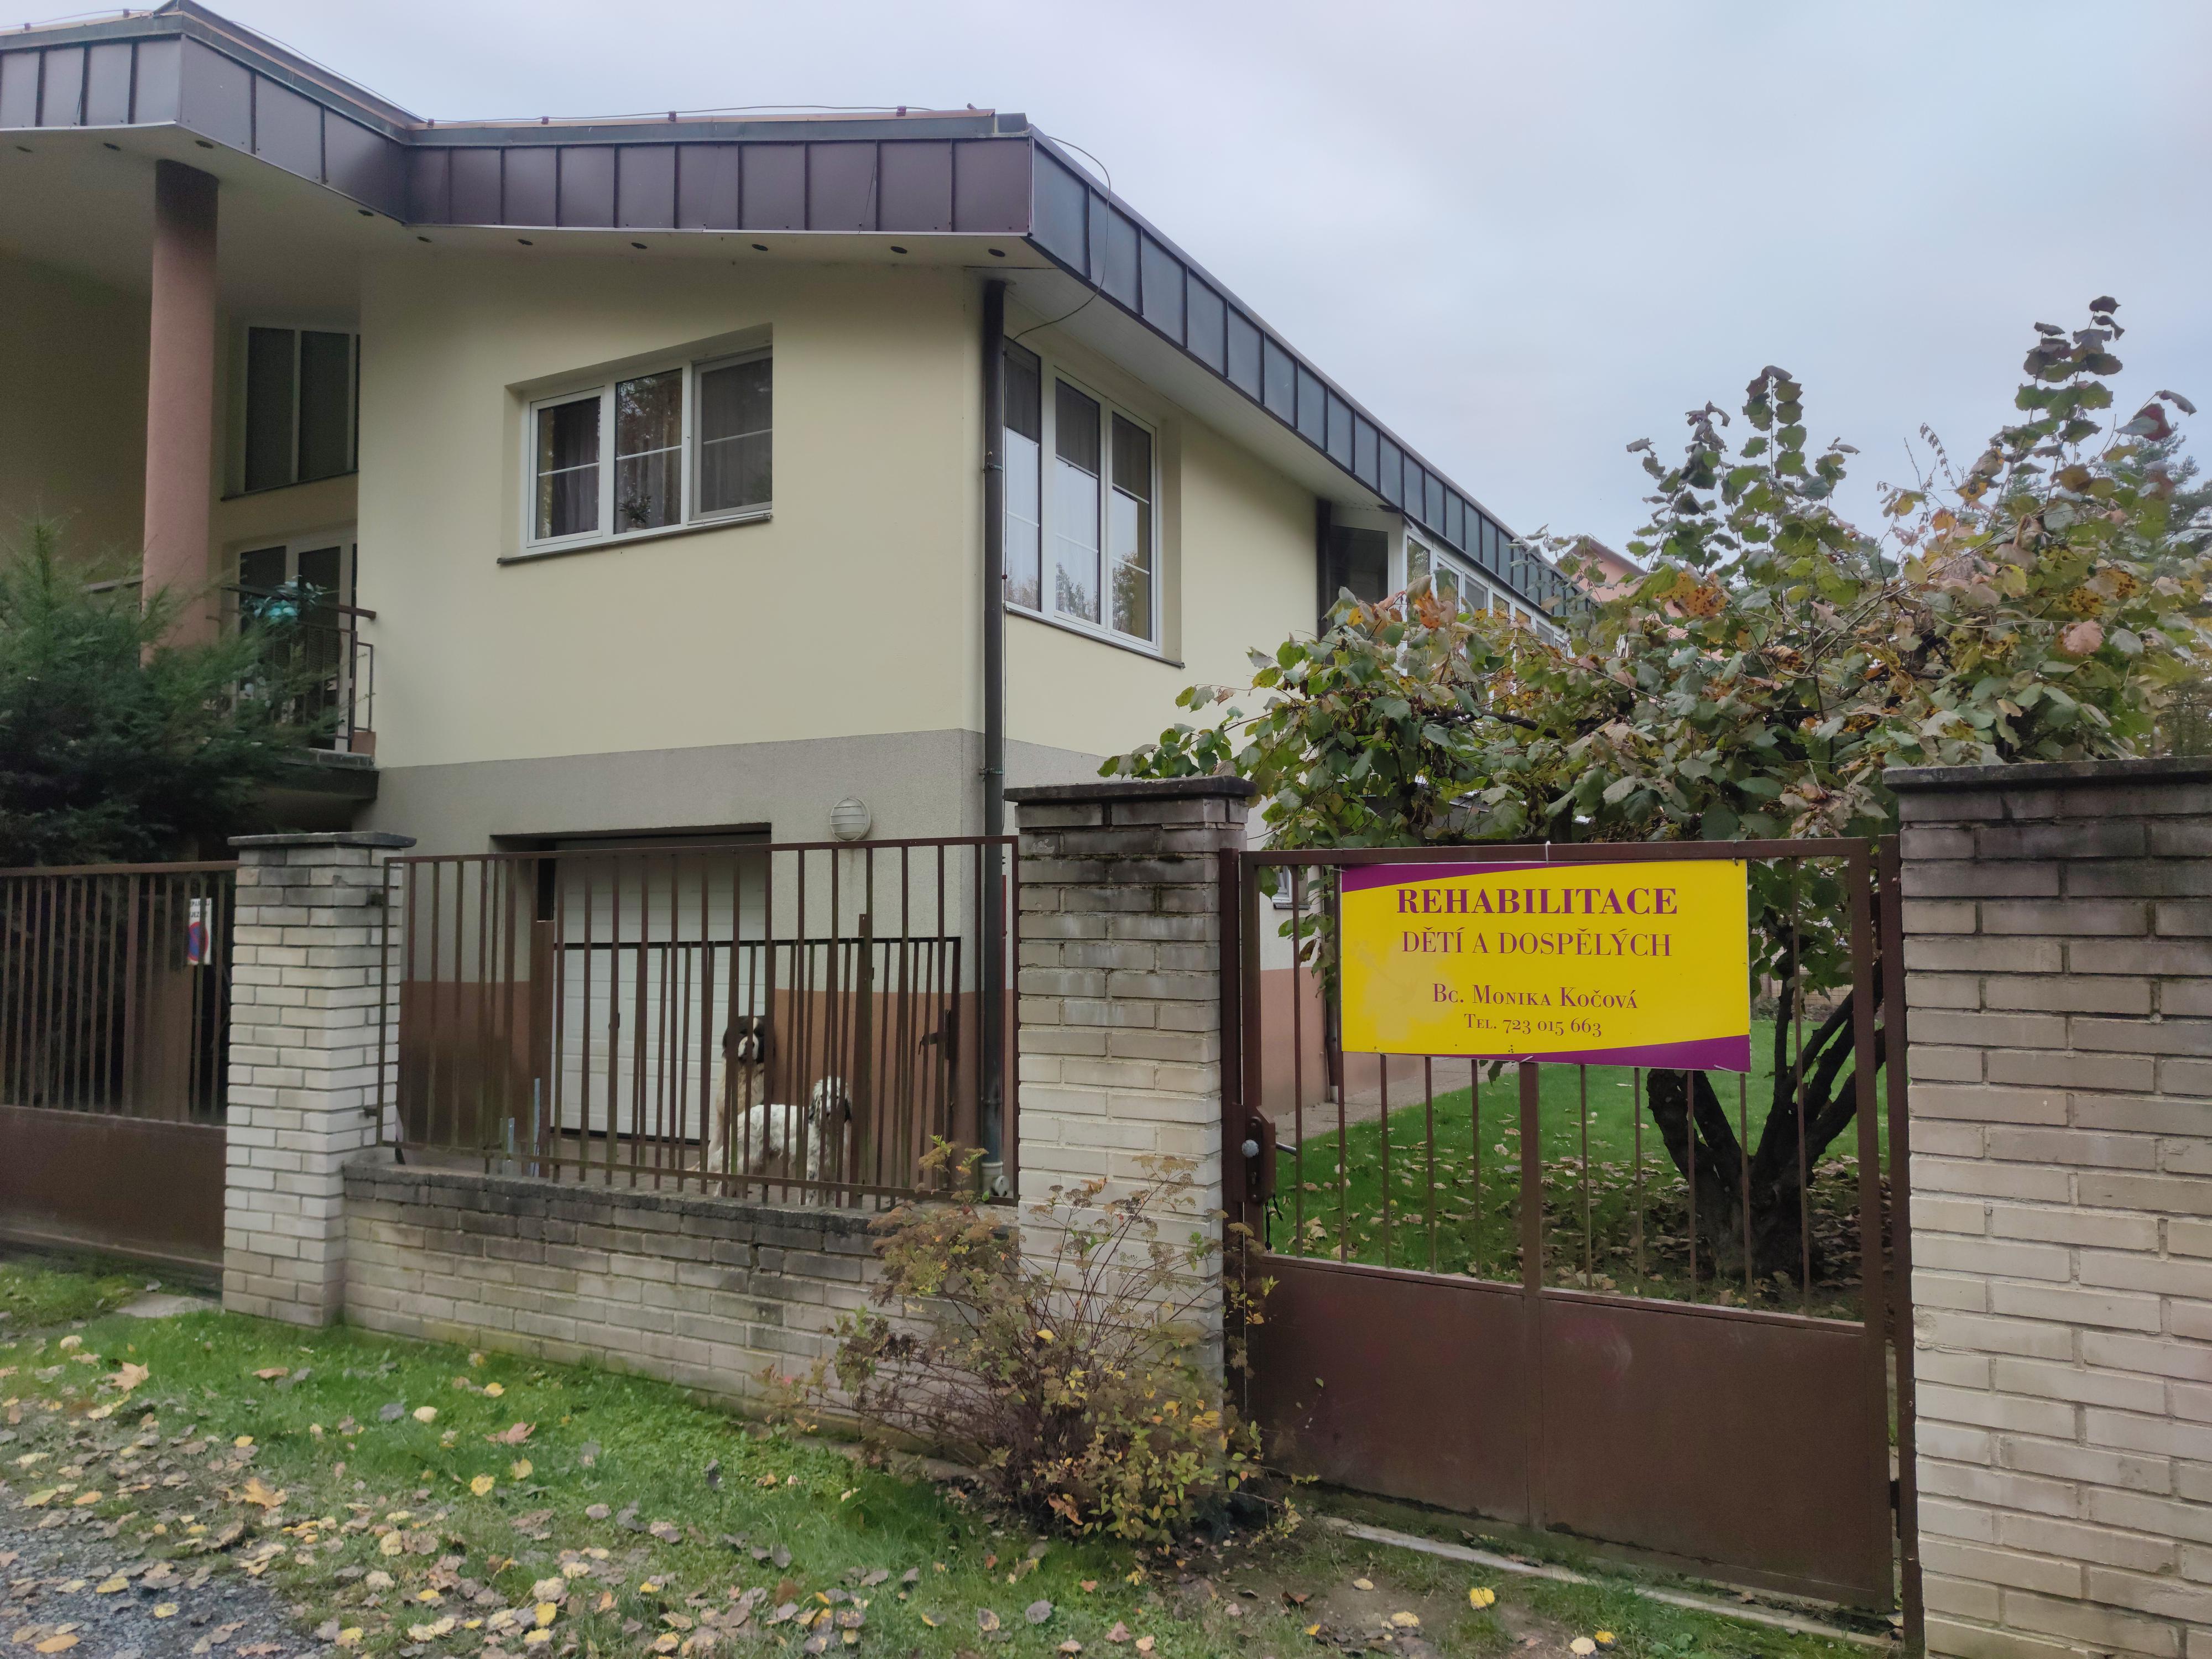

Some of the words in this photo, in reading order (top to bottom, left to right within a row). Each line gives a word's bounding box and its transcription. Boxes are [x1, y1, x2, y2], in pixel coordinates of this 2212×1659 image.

[1397, 888, 1677, 915] REHABILITACE
[1402, 926, 1465, 953] DĚTÍ
[1472, 932, 1490, 953] A
[1498, 928, 1672, 957] DOSPĚLÝCH
[1503, 1019, 1531, 1035] 723
[1537, 1020, 1564, 1036] 015
[1571, 1018, 1601, 1037] 663
